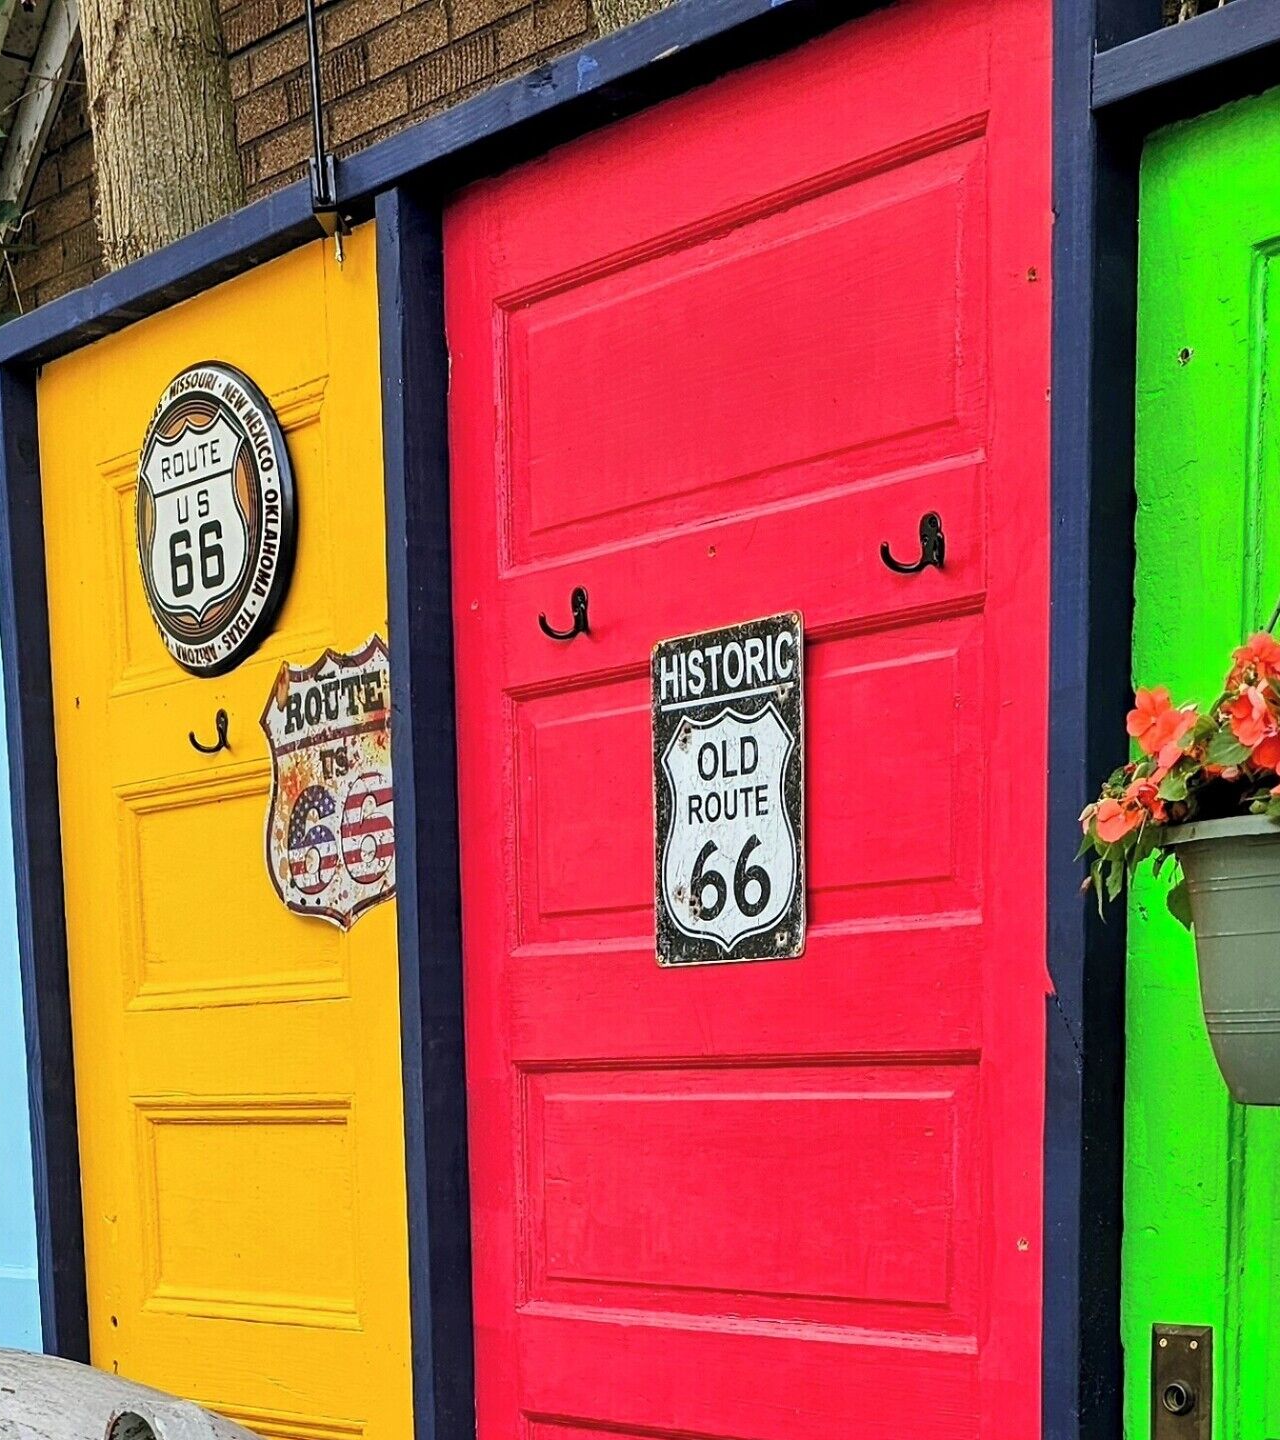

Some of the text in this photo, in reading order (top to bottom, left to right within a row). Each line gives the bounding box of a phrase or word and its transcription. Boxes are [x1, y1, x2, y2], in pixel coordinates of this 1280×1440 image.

[169, 371, 218, 398] MISSOURI
[222, 383, 274, 472] NEW MEXICO
[161, 438, 222, 483] ROUTE
[176, 488, 210, 525] US
[169, 519, 225, 599] 66
[252, 488, 279, 604] OKLAHOMA
[222, 611, 257, 652] TEXAS
[176, 645, 219, 666] ARIZONA
[659, 629, 795, 701] HISTORIC
[284, 670, 385, 736] ROUTE
[319, 745, 350, 782] US
[697, 735, 760, 782] OLD
[687, 784, 770, 826] ROUTE
[287, 771, 396, 895] 66
[689, 833, 772, 922] 66
